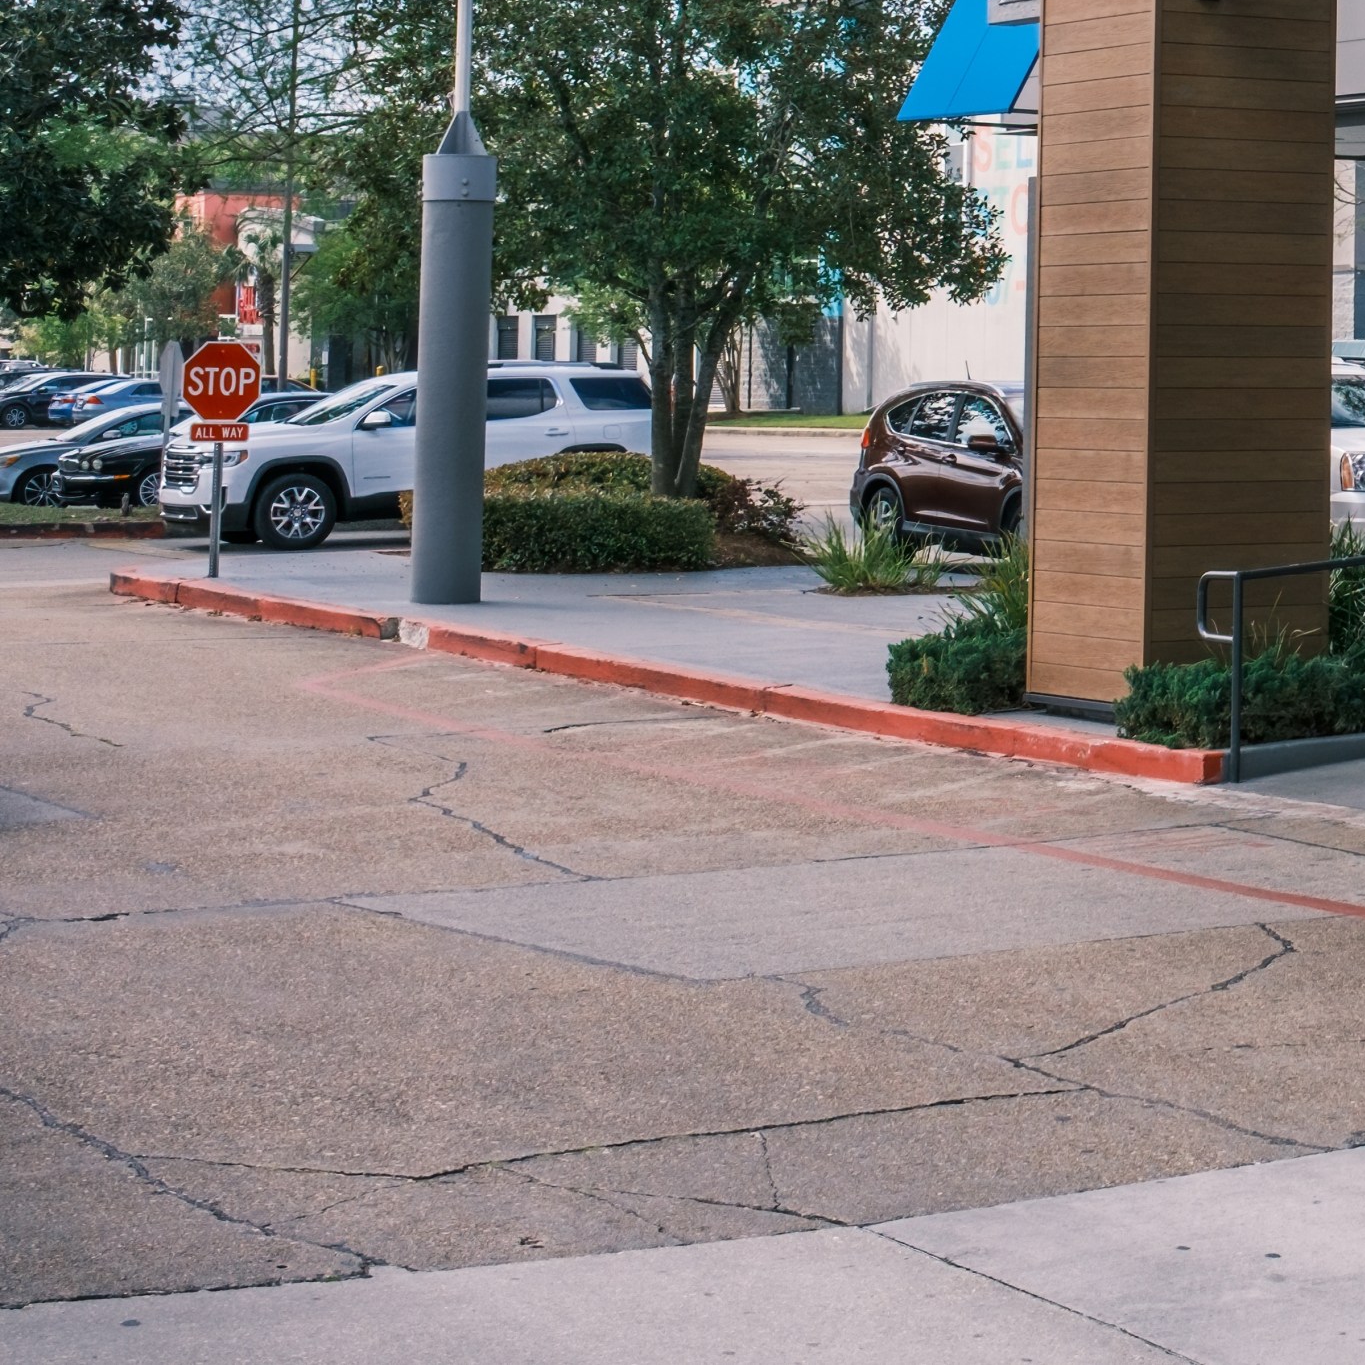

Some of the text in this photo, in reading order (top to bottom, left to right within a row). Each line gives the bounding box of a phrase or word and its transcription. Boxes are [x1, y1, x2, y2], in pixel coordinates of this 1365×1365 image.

[975, 126, 1033, 172] SEL
[188, 366, 257, 396] STOP
[195, 426, 244, 439] ALL WAY
